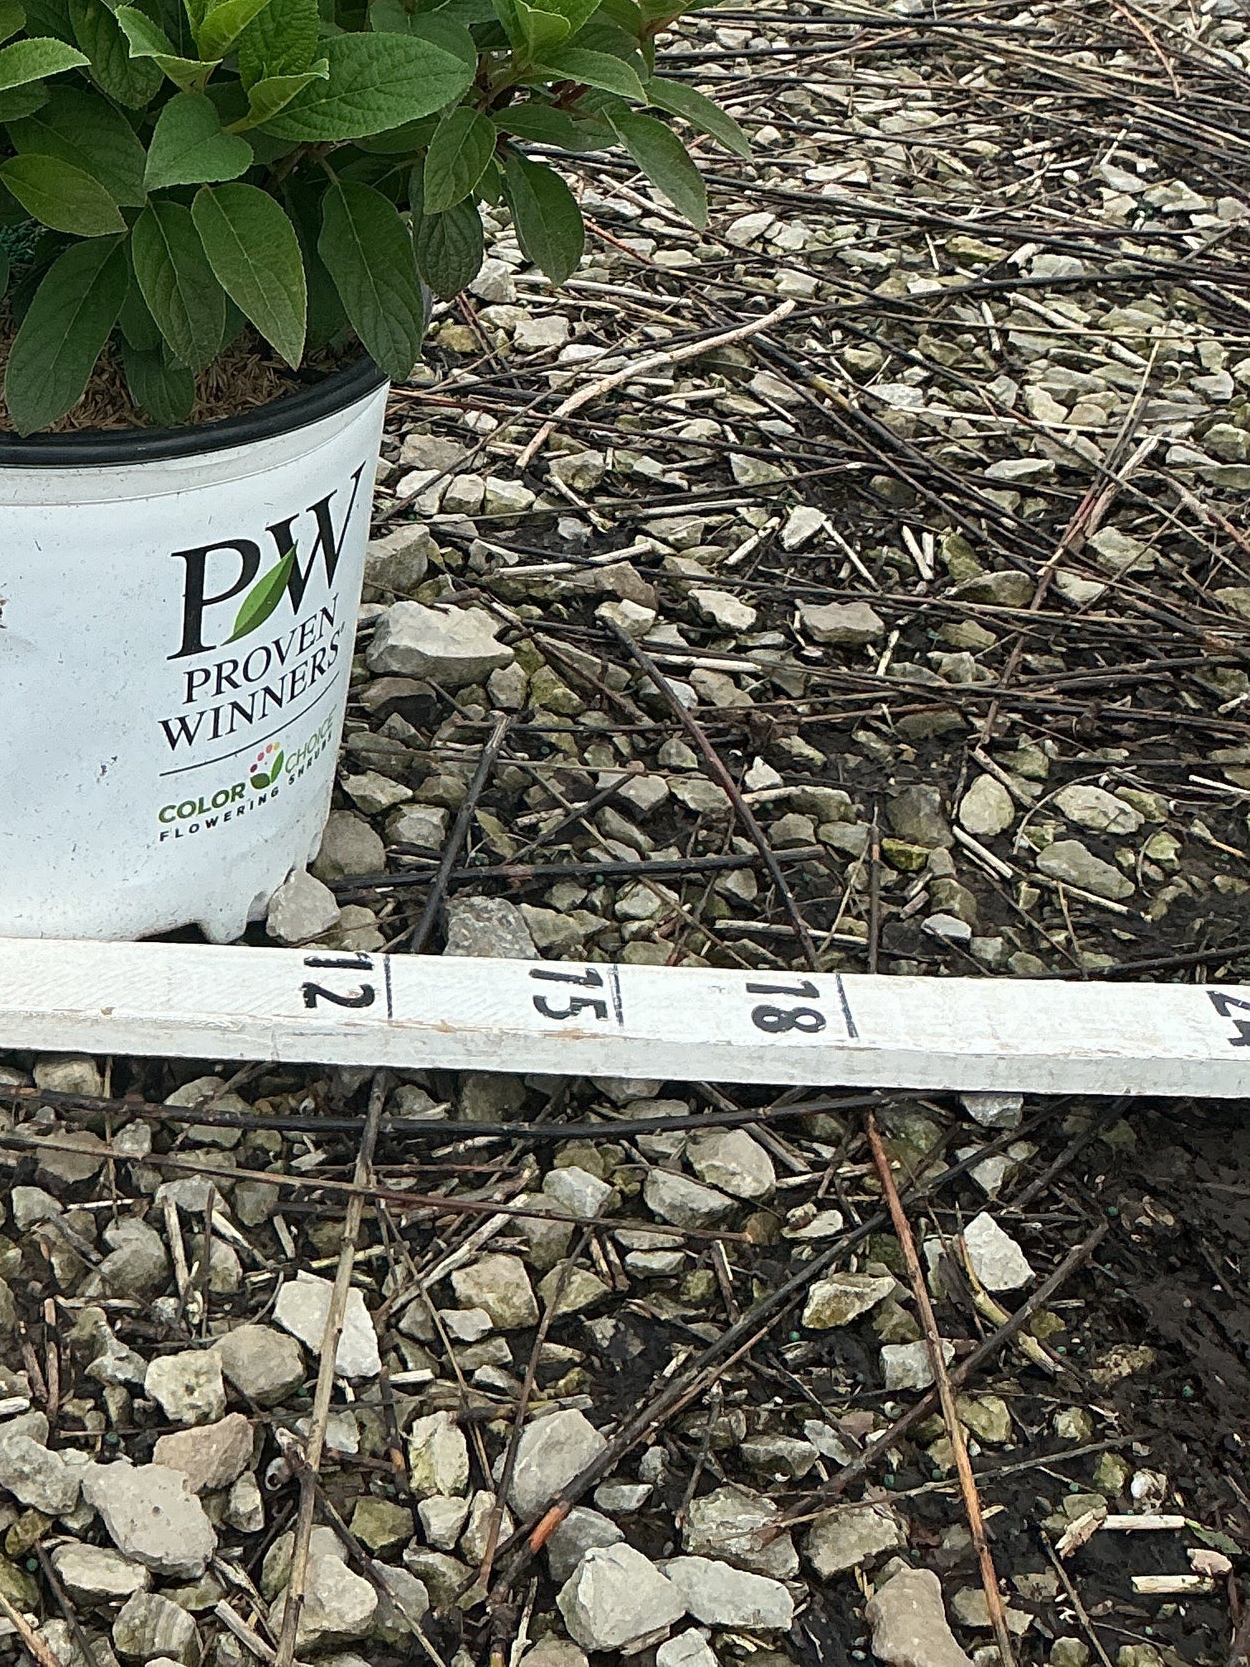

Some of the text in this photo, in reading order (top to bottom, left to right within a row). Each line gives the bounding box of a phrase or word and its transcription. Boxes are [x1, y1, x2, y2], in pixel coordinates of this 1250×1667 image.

[166, 460, 366, 660] PW
[182, 592, 339, 704] PROVEN
[158, 782, 246, 823] COLOR
[159, 730, 332, 842] FLOWERING SHRUBS
[301, 951, 376, 1009] 12
[528, 967, 609, 1021] 15
[745, 979, 827, 1034] 18
